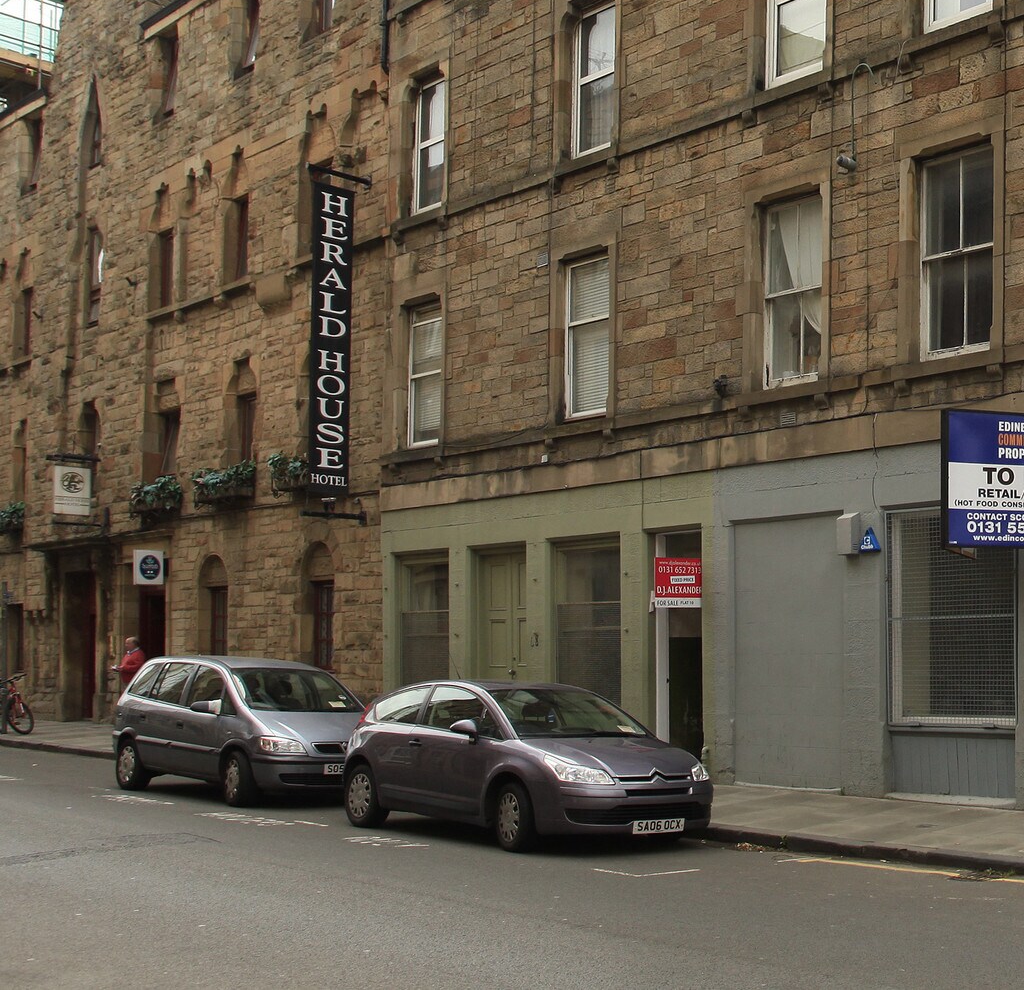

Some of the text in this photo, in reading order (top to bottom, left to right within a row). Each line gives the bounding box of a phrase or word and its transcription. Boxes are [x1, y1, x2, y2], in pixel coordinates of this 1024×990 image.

[315, 191, 348, 470] HERALD HOUSE
[310, 473, 347, 487] HOTEL
[983, 467, 1014, 485] TO
[967, 513, 1007, 521] CONTACT
[967, 521, 1001, 533] 0131
[675, 566, 686, 574] 652
[637, 819, 681, 831] SA06 OCX
